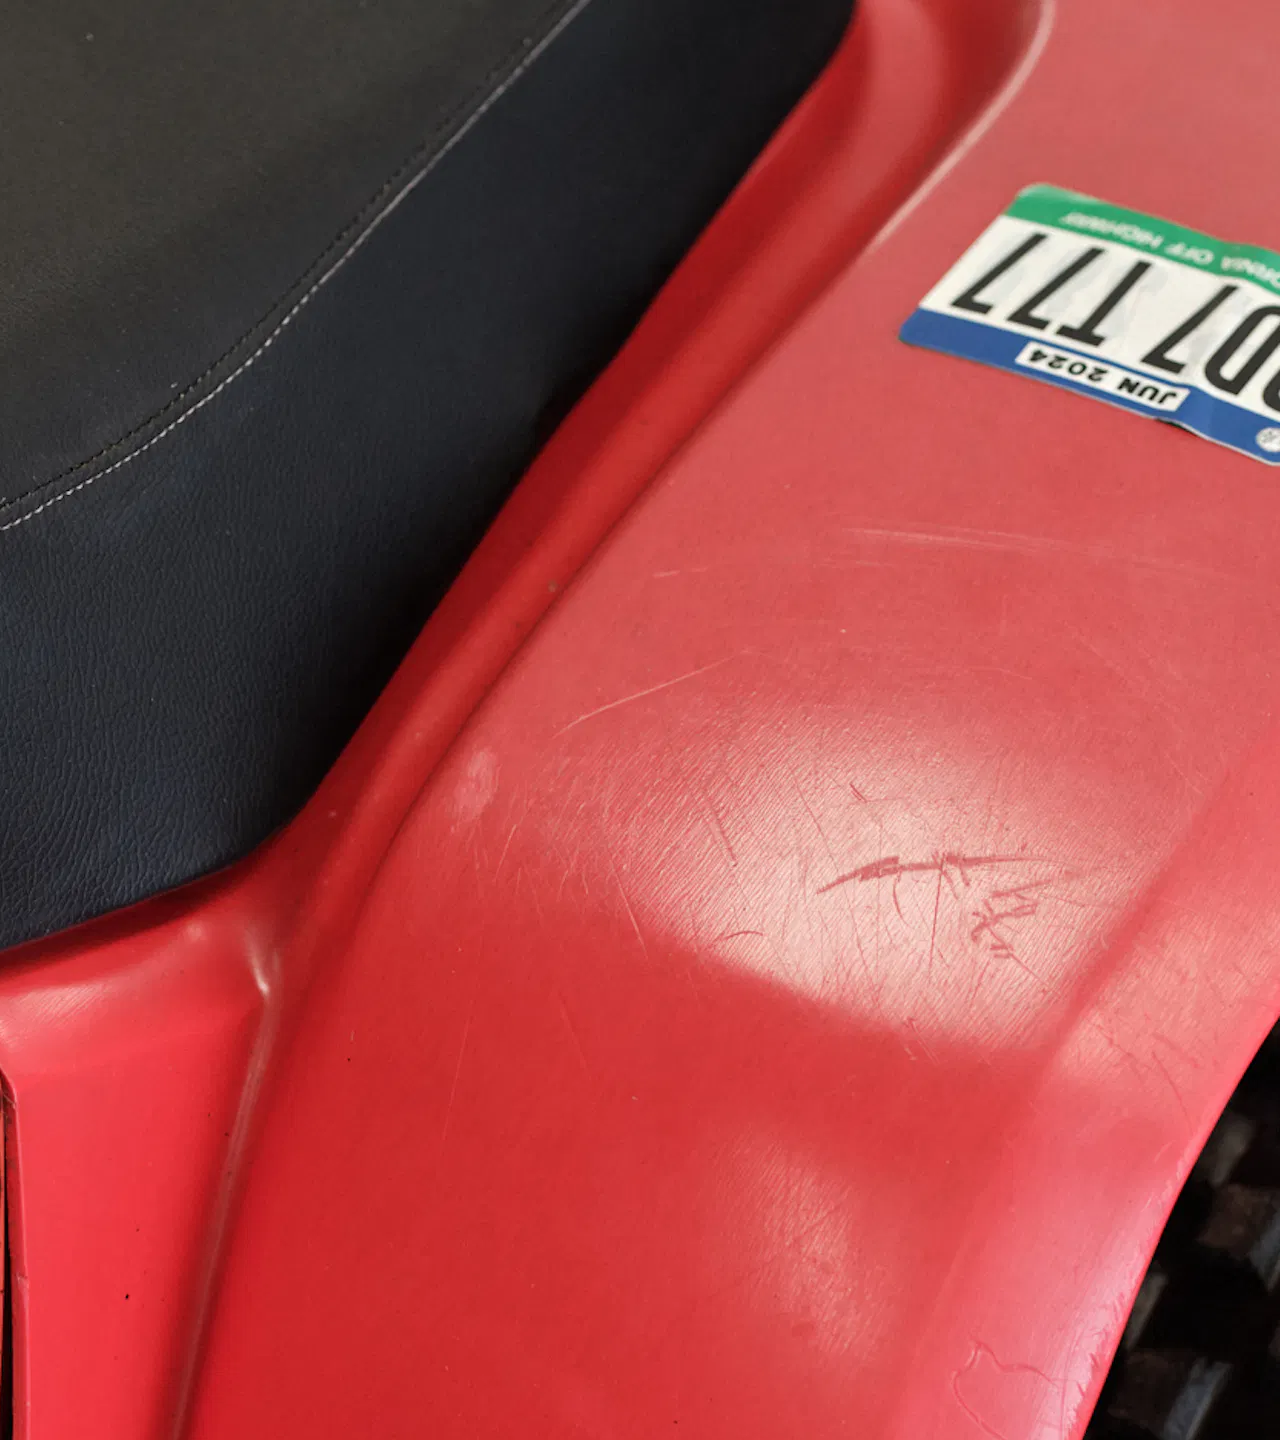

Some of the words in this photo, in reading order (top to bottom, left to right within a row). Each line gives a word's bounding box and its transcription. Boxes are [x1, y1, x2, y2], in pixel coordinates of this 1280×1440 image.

[1165, 240, 1216, 266] OFF
[1021, 347, 1108, 383] 2024
[1117, 376, 1178, 406] JUN
